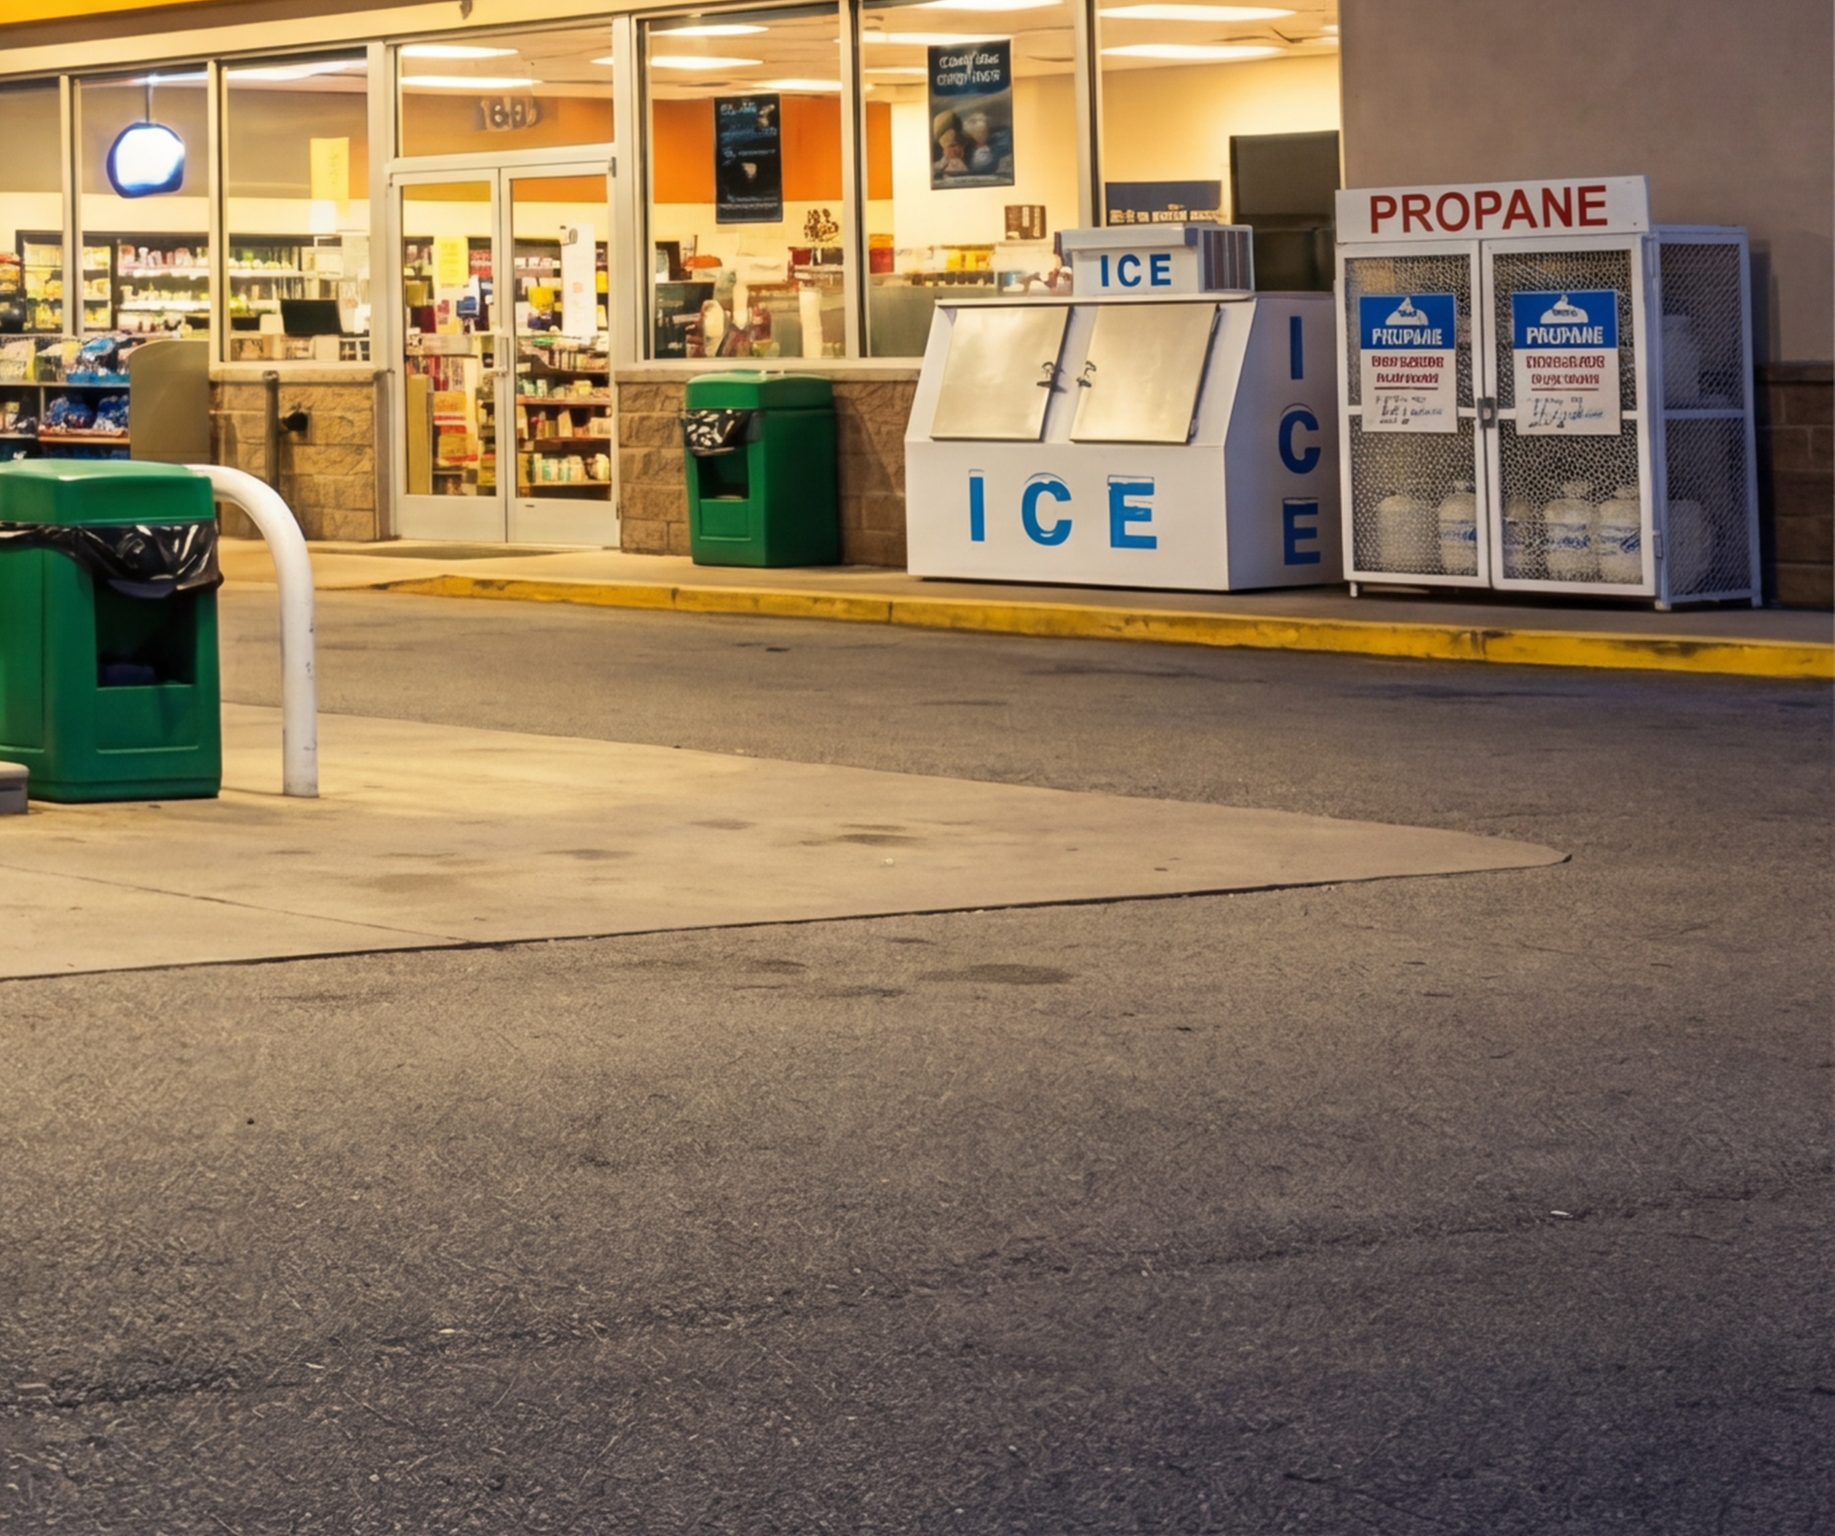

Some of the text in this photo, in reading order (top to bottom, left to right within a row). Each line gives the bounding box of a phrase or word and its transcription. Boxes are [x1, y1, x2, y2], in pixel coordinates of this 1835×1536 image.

[1370, 185, 1608, 234] PROPANE
[1100, 253, 1172, 288] ICE
[968, 471, 1158, 550] ICE
